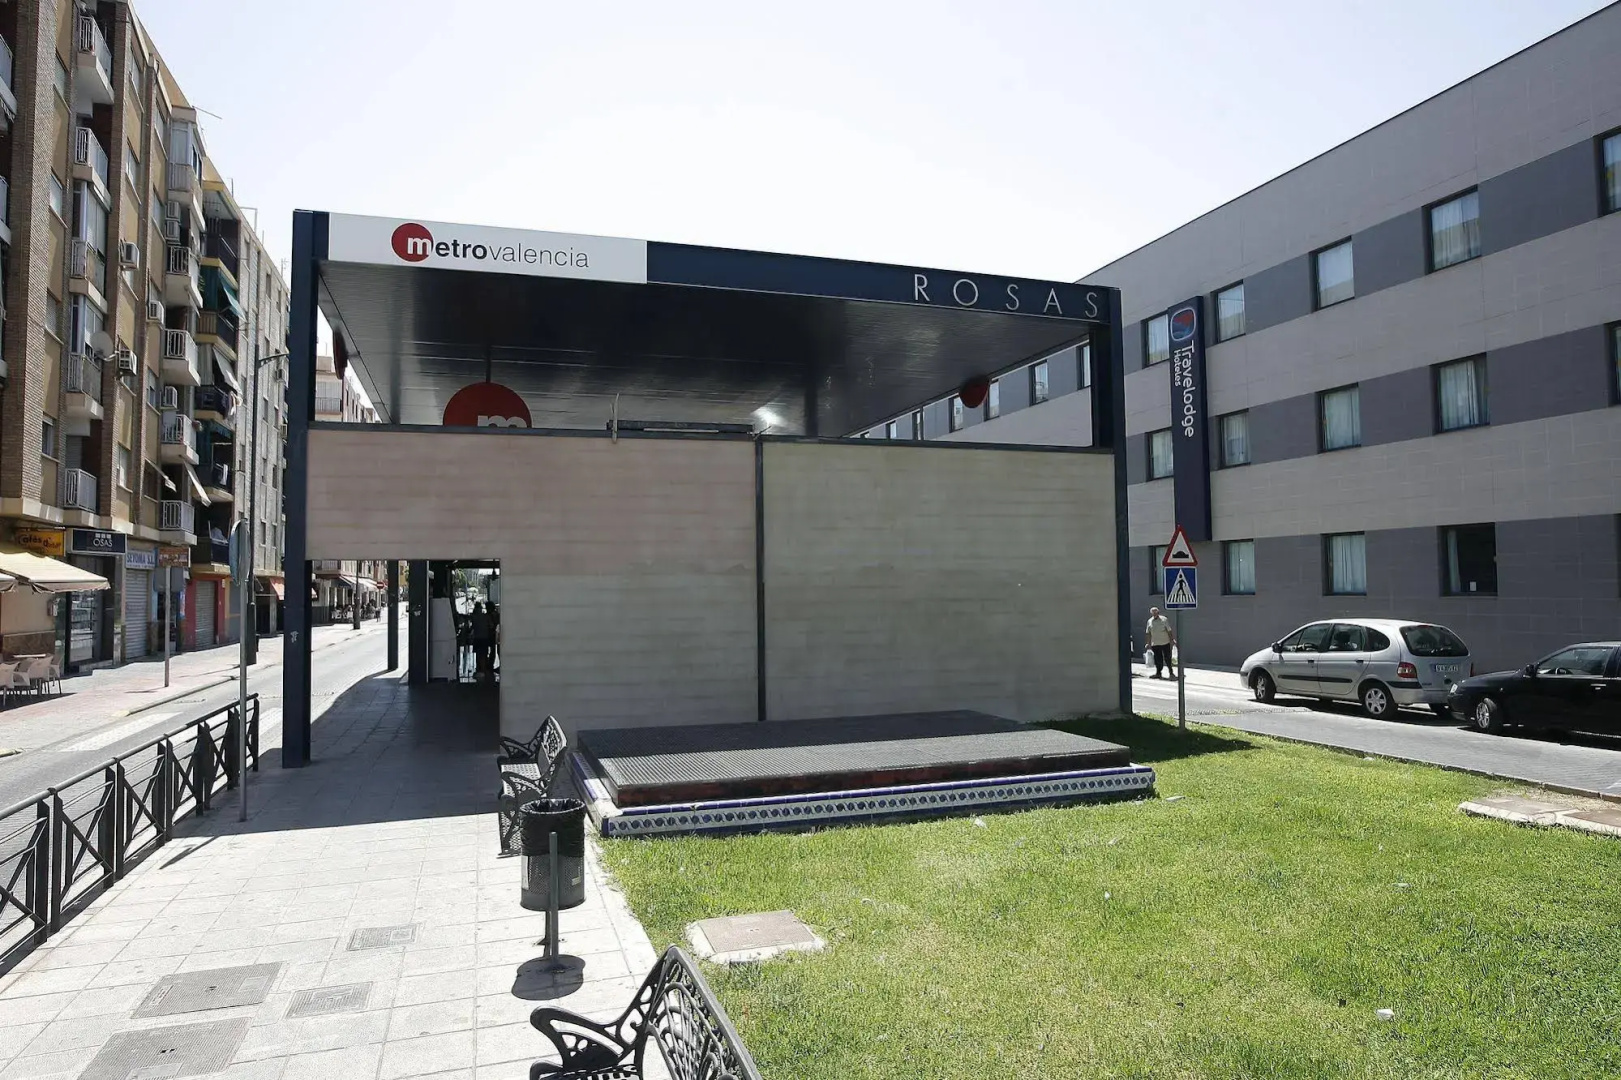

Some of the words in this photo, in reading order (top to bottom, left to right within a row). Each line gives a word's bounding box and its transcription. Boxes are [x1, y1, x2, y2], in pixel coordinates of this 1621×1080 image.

[407, 236, 589, 268] metrovalencia
[913, 273, 1099, 319] ROSAS
[1173, 349, 1182, 387] Hoteles
[1181, 339, 1197, 438] Travelodge
